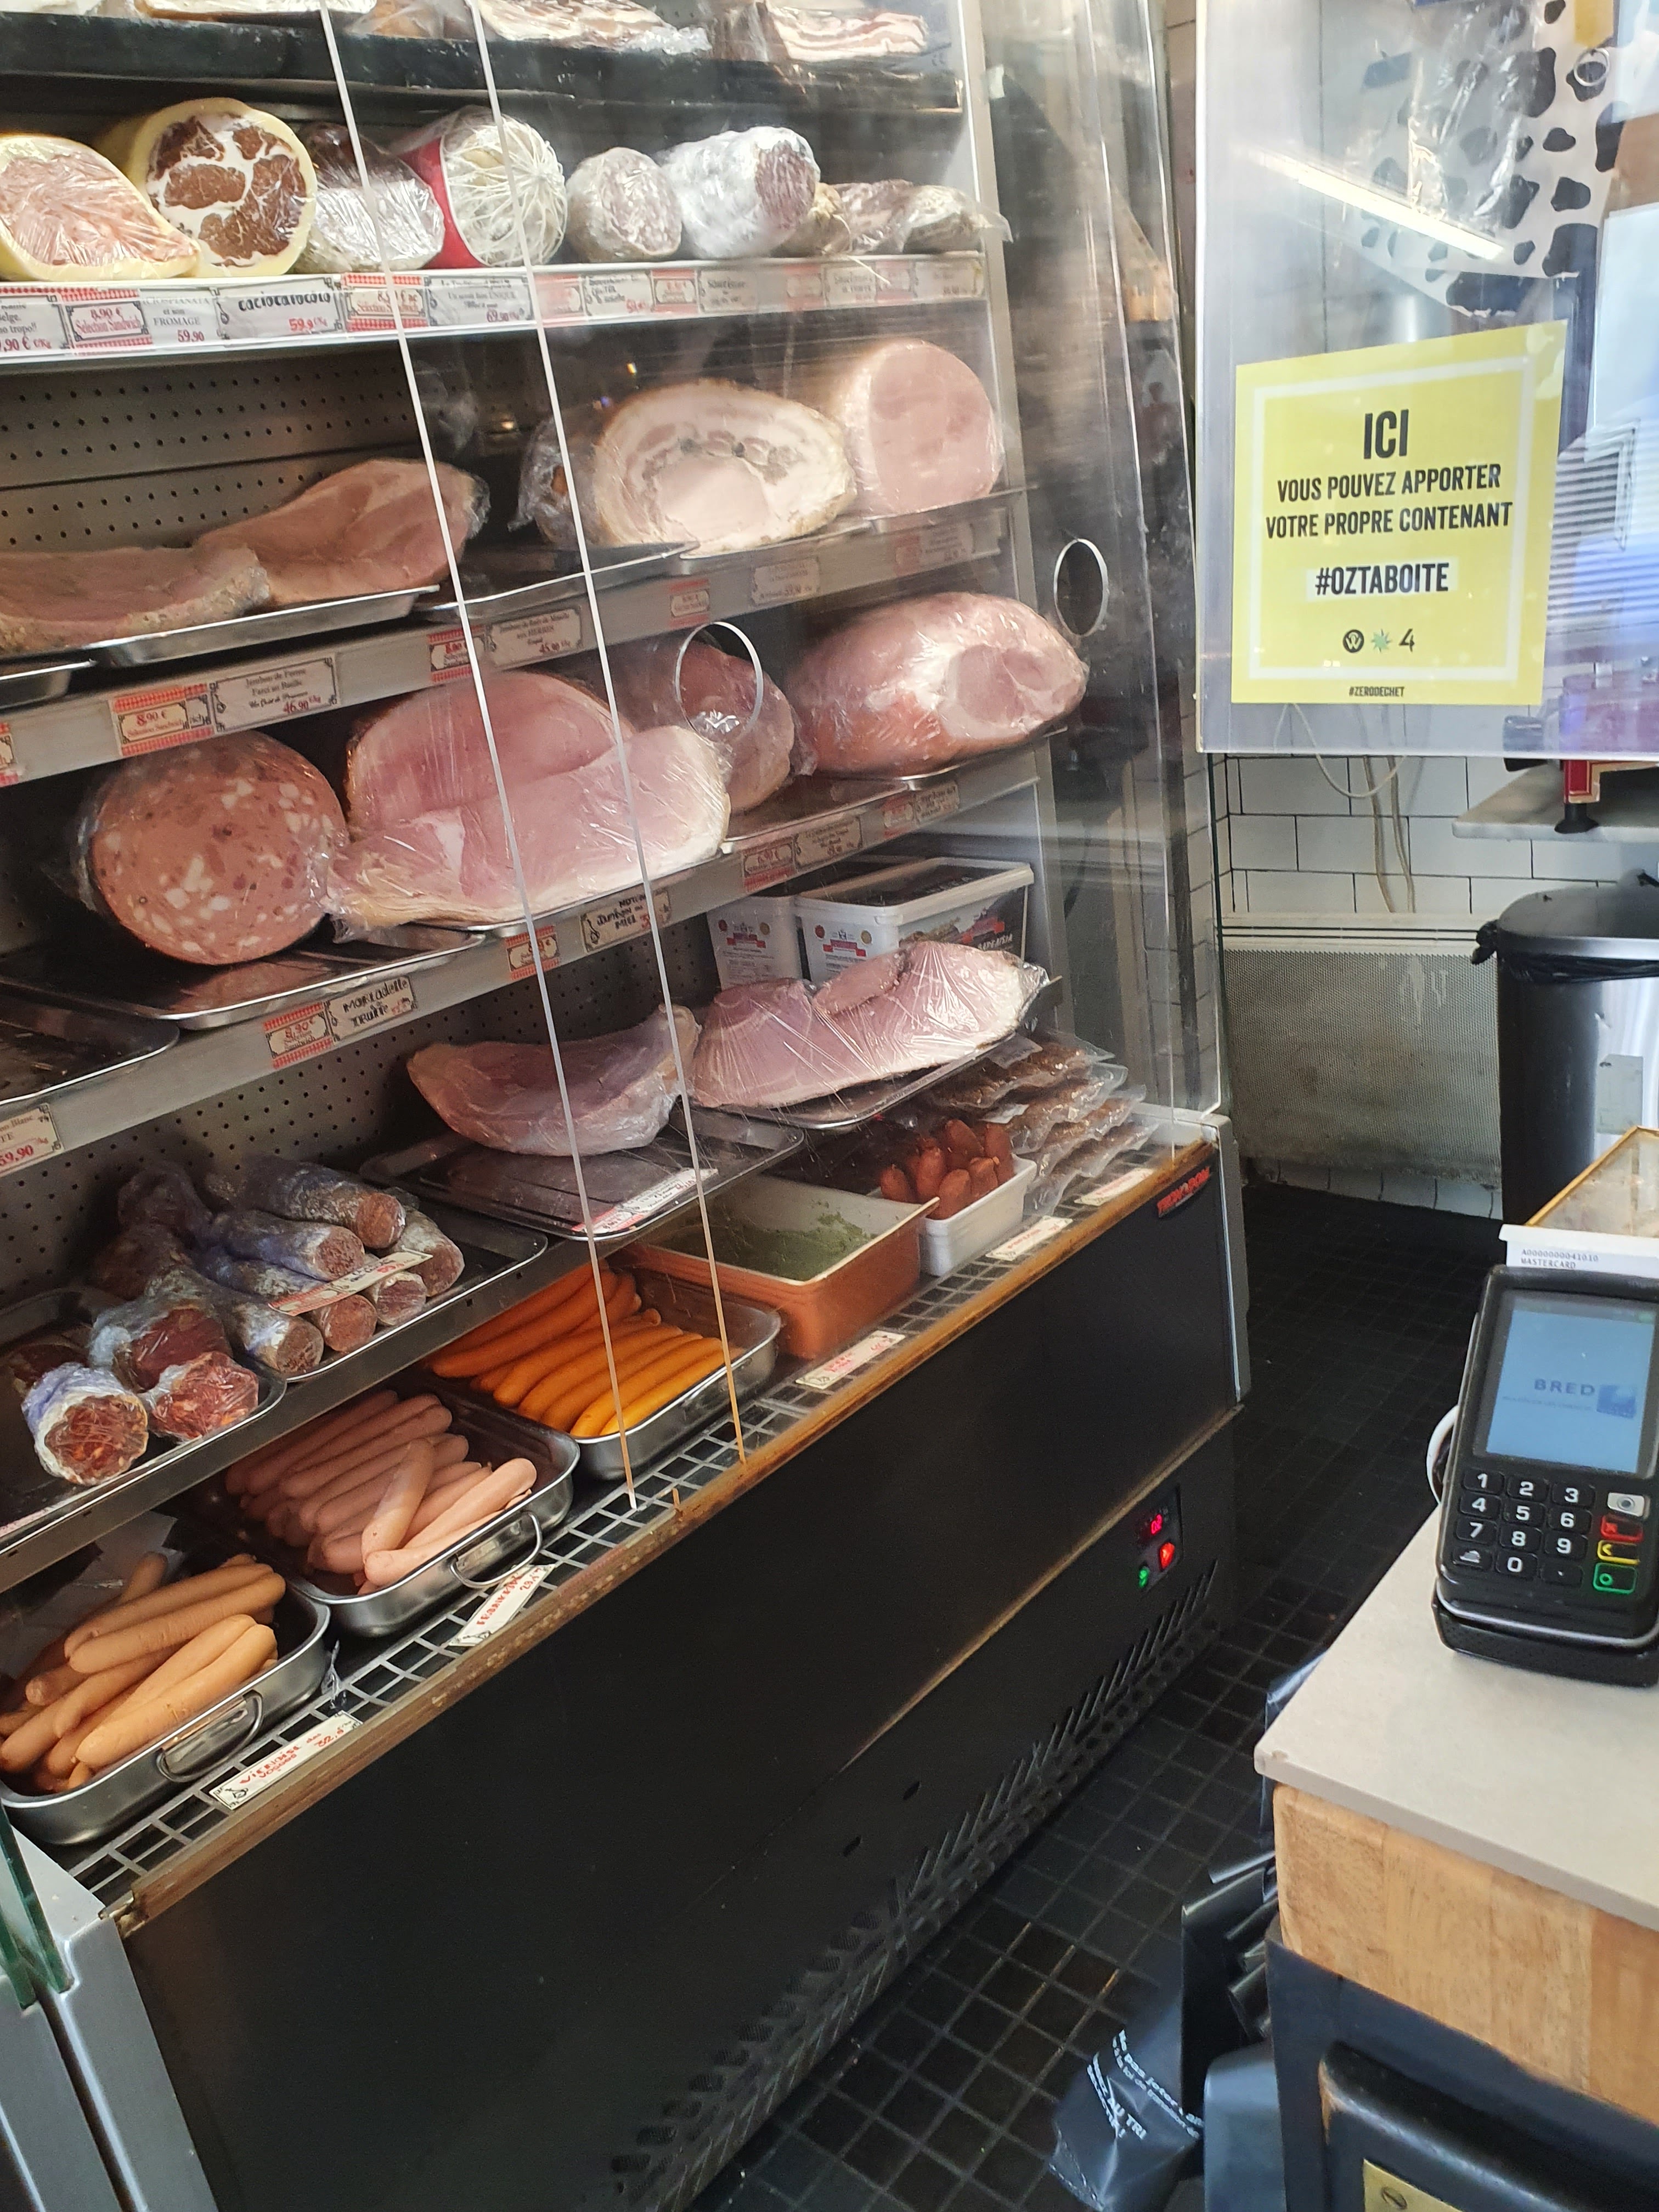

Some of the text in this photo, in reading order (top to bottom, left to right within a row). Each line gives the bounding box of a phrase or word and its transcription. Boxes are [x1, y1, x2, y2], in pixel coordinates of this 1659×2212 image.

[153, 317, 201, 326] FROMAGE
[1363, 409, 1410, 460] ICI
[1277, 464, 1502, 503] VOUS POUVEZ APPORTER
[1266, 502, 1513, 539] VOTRE PROPRE CONTENANT
[1316, 562, 1450, 596] #OZTABOITE
[1521, 1257, 1576, 1269] MASTERCARD
[1534, 1378, 1595, 1396] BRED
[1477, 1473, 1579, 1503] 1 2 3
[1472, 1497, 1575, 1528] 4 5 6
[1469, 1521, 1572, 1555] 7 8 9
[1507, 1556, 1523, 1573] 0
[1125, 2113, 1147, 2140] TRI
